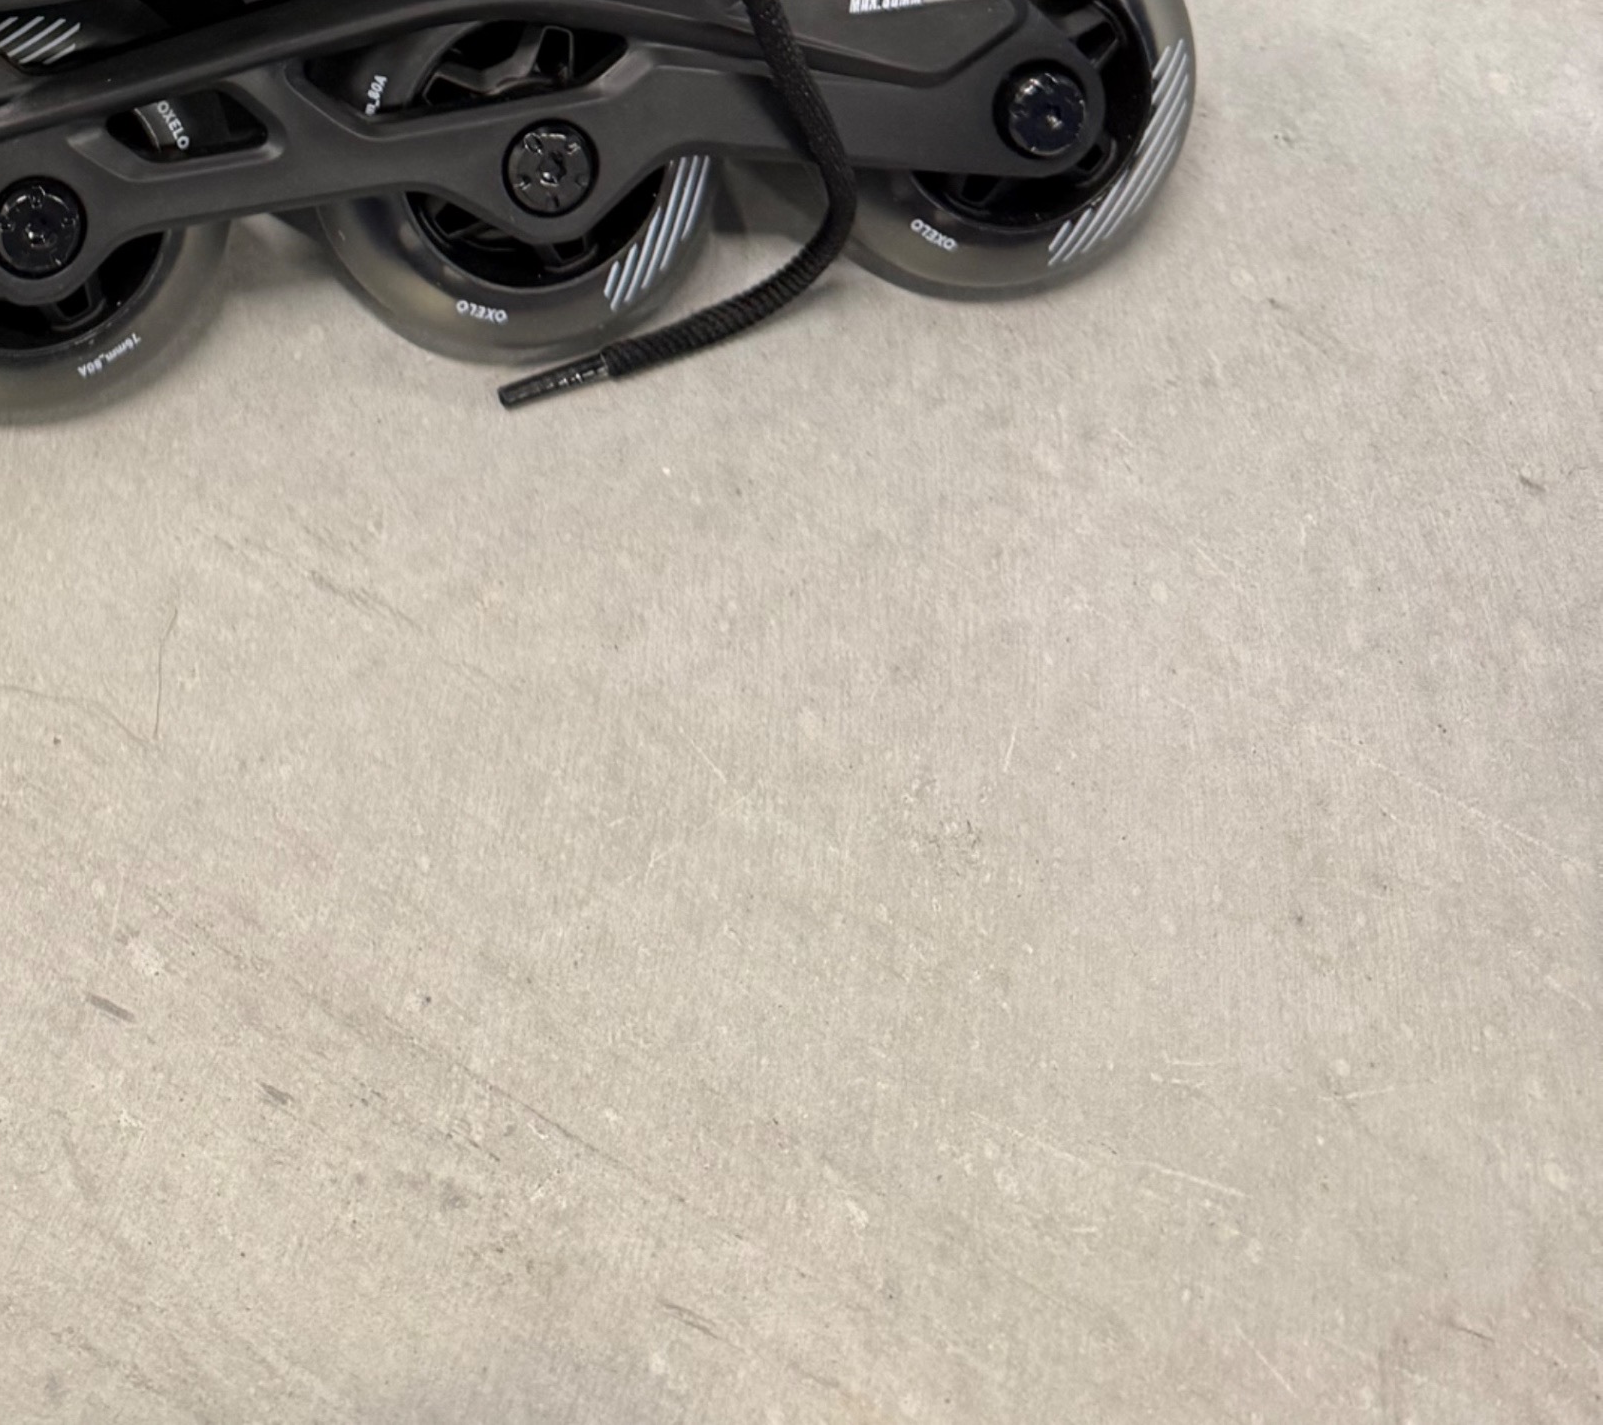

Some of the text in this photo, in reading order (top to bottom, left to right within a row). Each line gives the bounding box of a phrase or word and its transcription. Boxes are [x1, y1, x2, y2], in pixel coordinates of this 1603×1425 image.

[155, 100, 191, 151] OXELO
[910, 218, 957, 252] OXELO
[455, 299, 509, 325] OXELO
